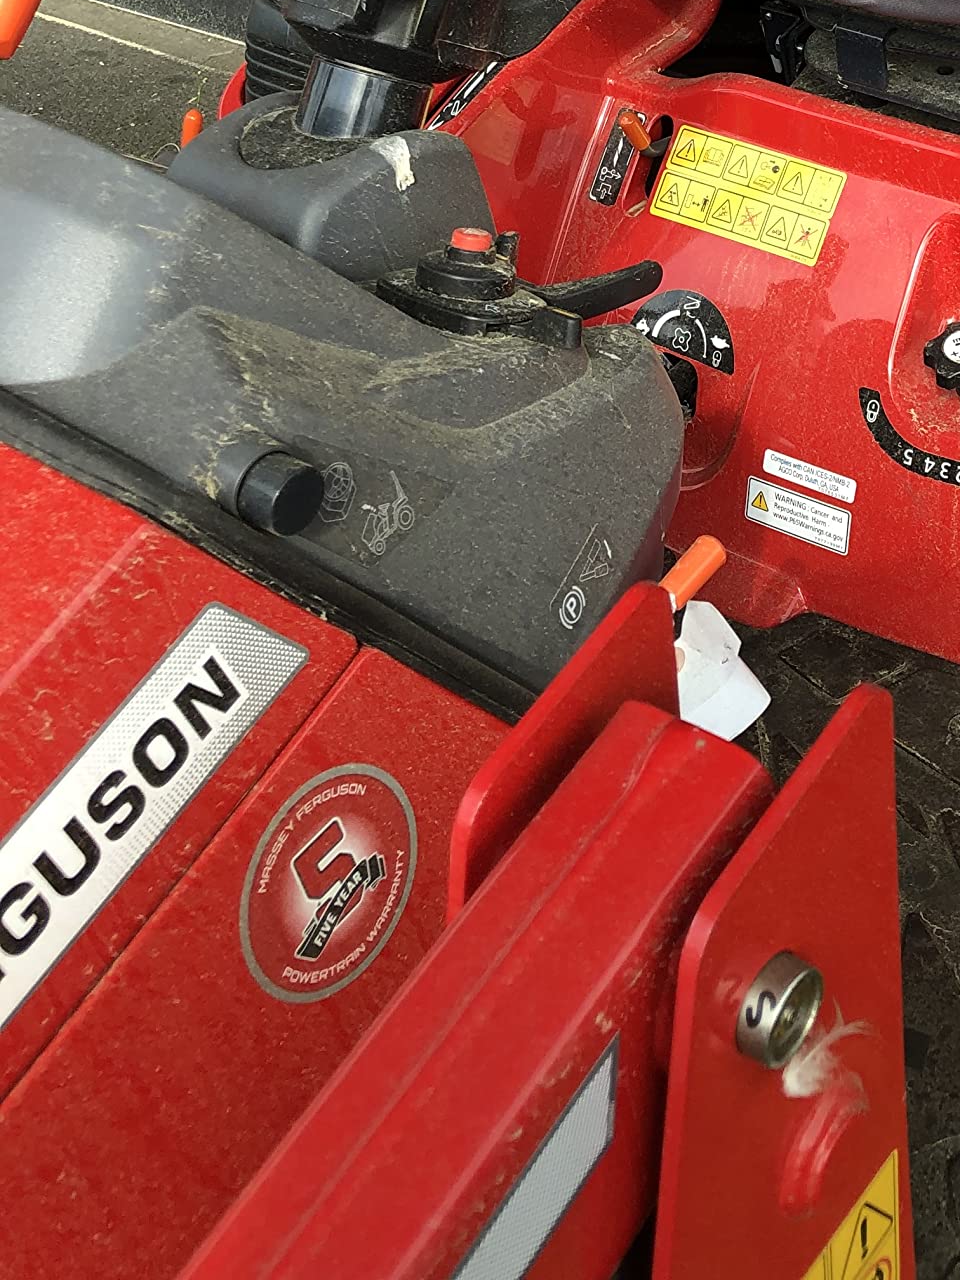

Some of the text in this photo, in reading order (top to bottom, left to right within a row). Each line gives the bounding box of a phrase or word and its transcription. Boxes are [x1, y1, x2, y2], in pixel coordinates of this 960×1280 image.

[903, 448, 914, 466] 5
[924, 456, 935, 473] 4
[940, 462, 951, 479] 3
[810, 507, 830, 519] Cancer
[831, 514, 843, 524] and
[257, 783, 367, 893] MASSEY FERGUSON
[282, 849, 405, 984] POWERTRAIN WARRANTY
[313, 871, 363, 948] FIVE YEAR
